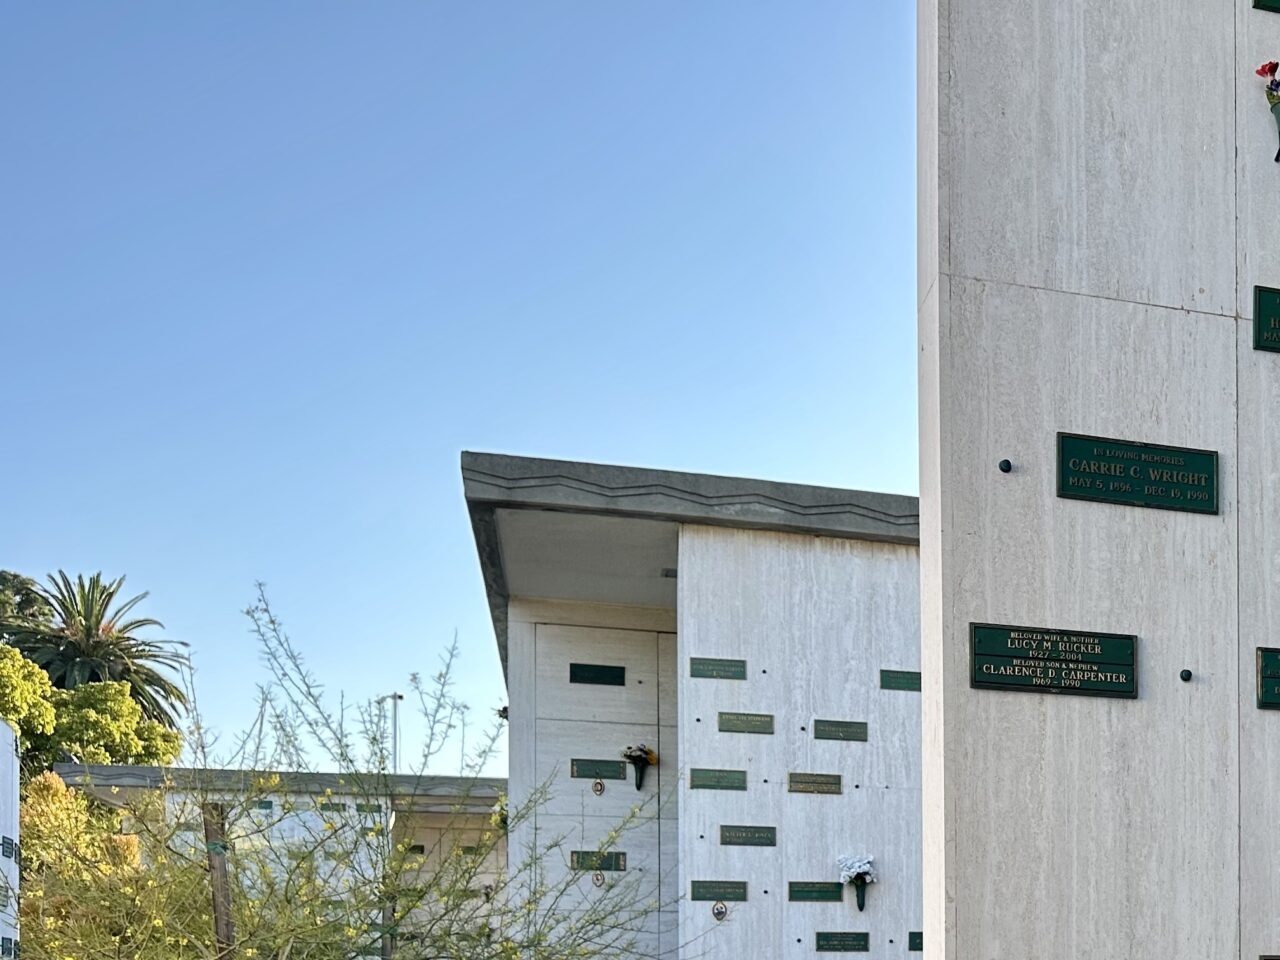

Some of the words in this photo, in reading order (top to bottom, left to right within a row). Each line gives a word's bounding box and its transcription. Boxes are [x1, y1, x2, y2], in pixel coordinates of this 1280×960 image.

[1106, 448, 1139, 460] LOVING
[1141, 453, 1185, 466] MEMORIES
[1069, 457, 1125, 477] CARRIE
[1148, 466, 1209, 487] WRIGHT
[1069, 476, 1091, 488] MAY
[1109, 480, 1132, 493] 1896
[1171, 488, 1184, 499] 19,
[1187, 490, 1209, 502] 1990
[1011, 631, 1042, 640] BELOVED
[1071, 636, 1099, 644] MOTHER
[1008, 638, 1039, 649] LUCY
[1059, 642, 1102, 654] RUCKER
[1029, 650, 1049, 659] 1927
[1060, 652, 1082, 661] 2004
[1013, 659, 1045, 667] BELOVED
[1069, 663, 1098, 671] NEPHEW
[983, 664, 1044, 678] CLARENCE
[1062, 669, 1127, 683] CARPENTER
[1033, 678, 1051, 686] 1969
[1061, 680, 1081, 688] 1990
